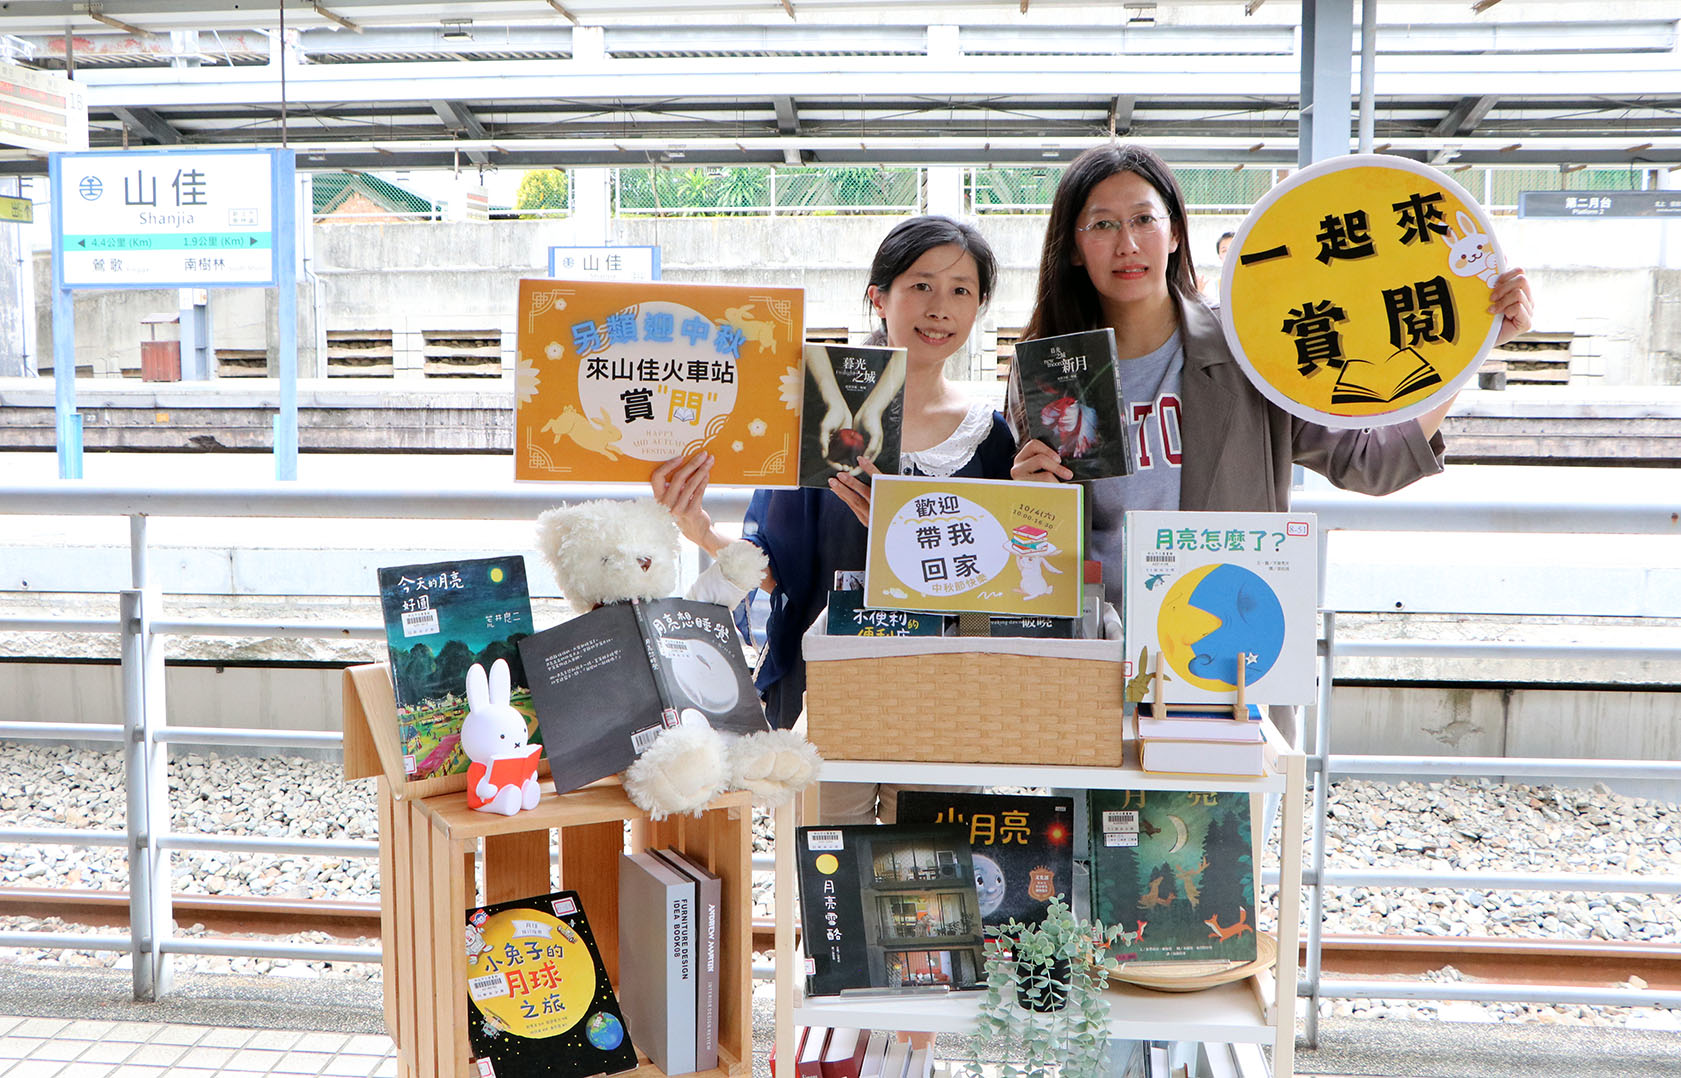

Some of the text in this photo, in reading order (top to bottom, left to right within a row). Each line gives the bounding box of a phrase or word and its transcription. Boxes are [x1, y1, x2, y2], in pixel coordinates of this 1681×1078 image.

[124, 169, 207, 206] 山佳
[1565, 196, 1612, 209] 第二月台
[139, 212, 195, 228] Shanjia
[1240, 191, 1450, 267] 一起來
[91, 236, 152, 249] 4.4公里 (Km)
[183, 235, 245, 248] 1.9公里 (Km)
[184, 257, 226, 272] 南樹林
[583, 254, 622, 271] 山佳
[571, 311, 747, 359] 另類迎中秋
[1281, 275, 1458, 378] 賞閱
[586, 357, 735, 384] 來山佳火車站
[843, 356, 867, 371] 暮光
[1063, 355, 1087, 374] 新月
[852, 370, 877, 384] 之城
[914, 495, 961, 518] 歡迎
[916, 522, 975, 549] 帶我
[1156, 527, 1287, 552] 月亮怎麼了?
[921, 553, 980, 583] 回家
[398, 570, 465, 594] 今天的月亮
[931, 573, 988, 593] 中秋節快樂
[652, 611, 731, 644] 月亮想睡覺
[673, 899, 681, 920] IDEA
[681, 898, 689, 980] FURNITURE DESIGN
[485, 941, 564, 973] 小兔子的
[505, 960, 563, 999] 月球
[520, 993, 566, 1019] 之旅
